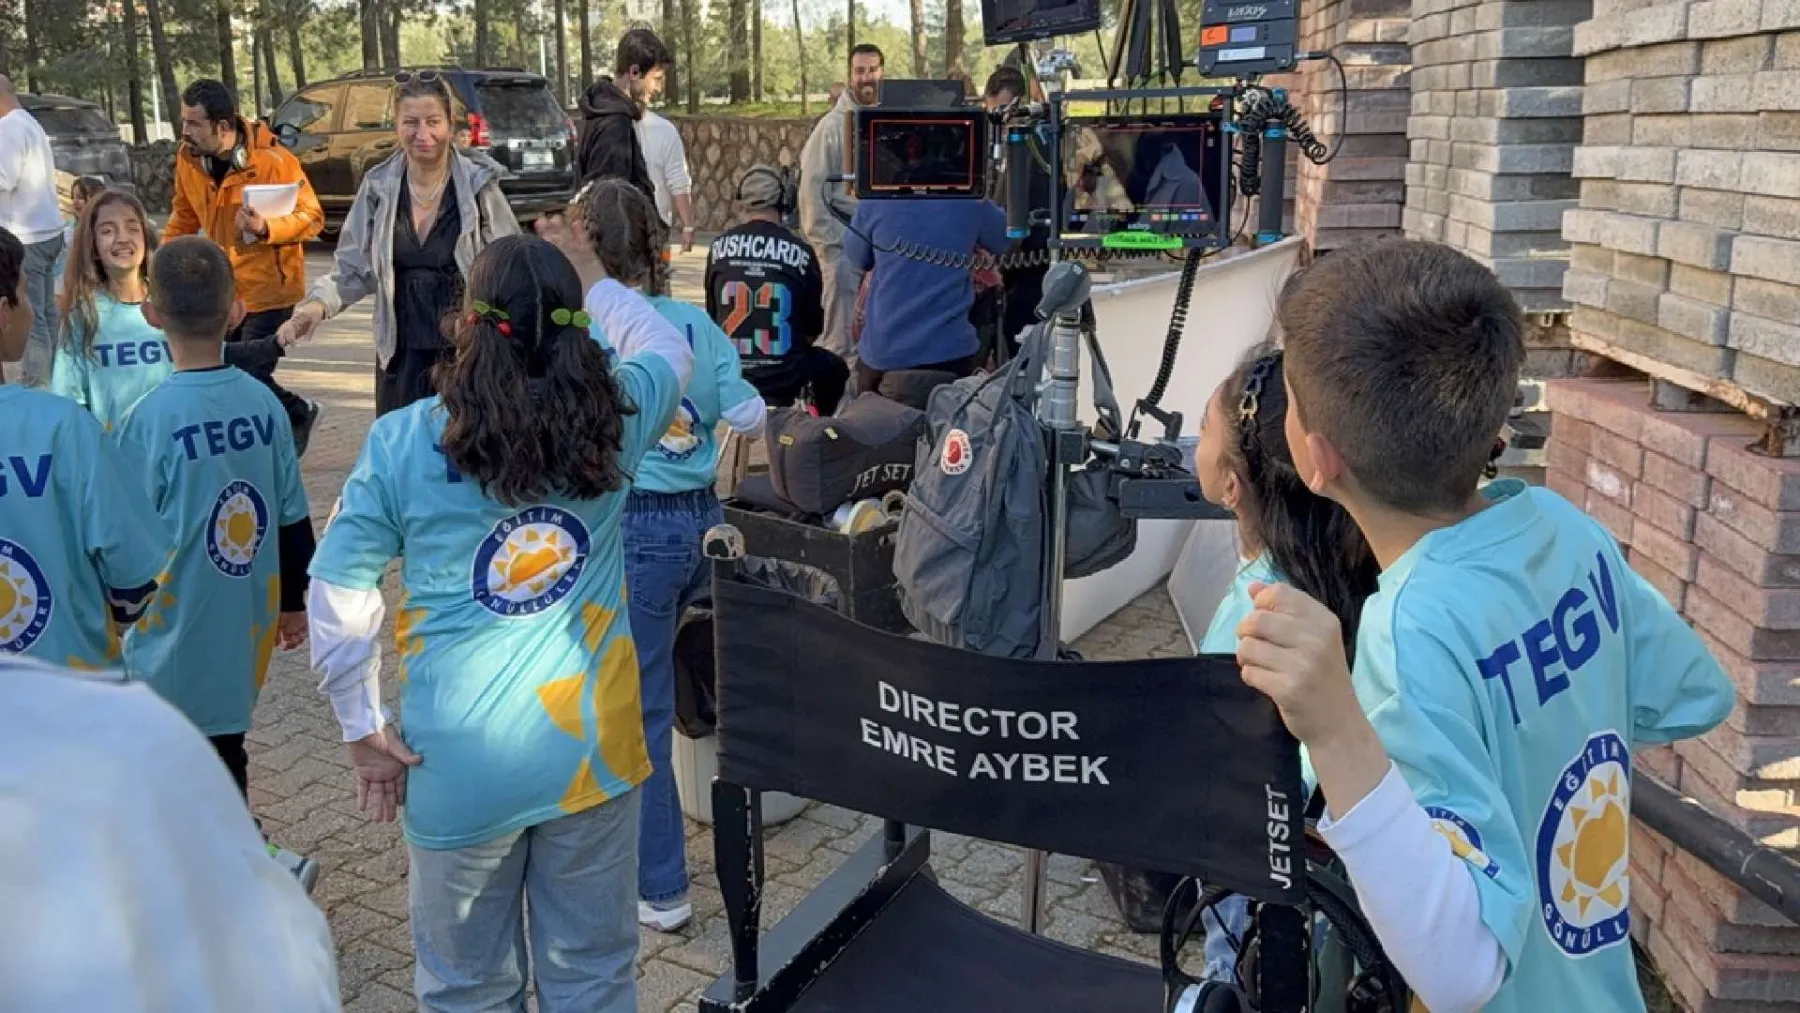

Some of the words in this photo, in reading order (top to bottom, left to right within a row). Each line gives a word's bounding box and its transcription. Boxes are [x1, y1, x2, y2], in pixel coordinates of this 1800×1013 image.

[721, 281, 792, 355] 23
[172, 414, 275, 461] TEGV
[847, 464, 881, 497] JET
[882, 463, 913, 482] SET
[1476, 550, 1620, 729] TEGV
[878, 680, 1080, 740] DIRECTOR
[860, 717, 957, 776] EMRE
[968, 752, 1110, 785] AYBEK
[1264, 783, 1292, 889] JETSET
